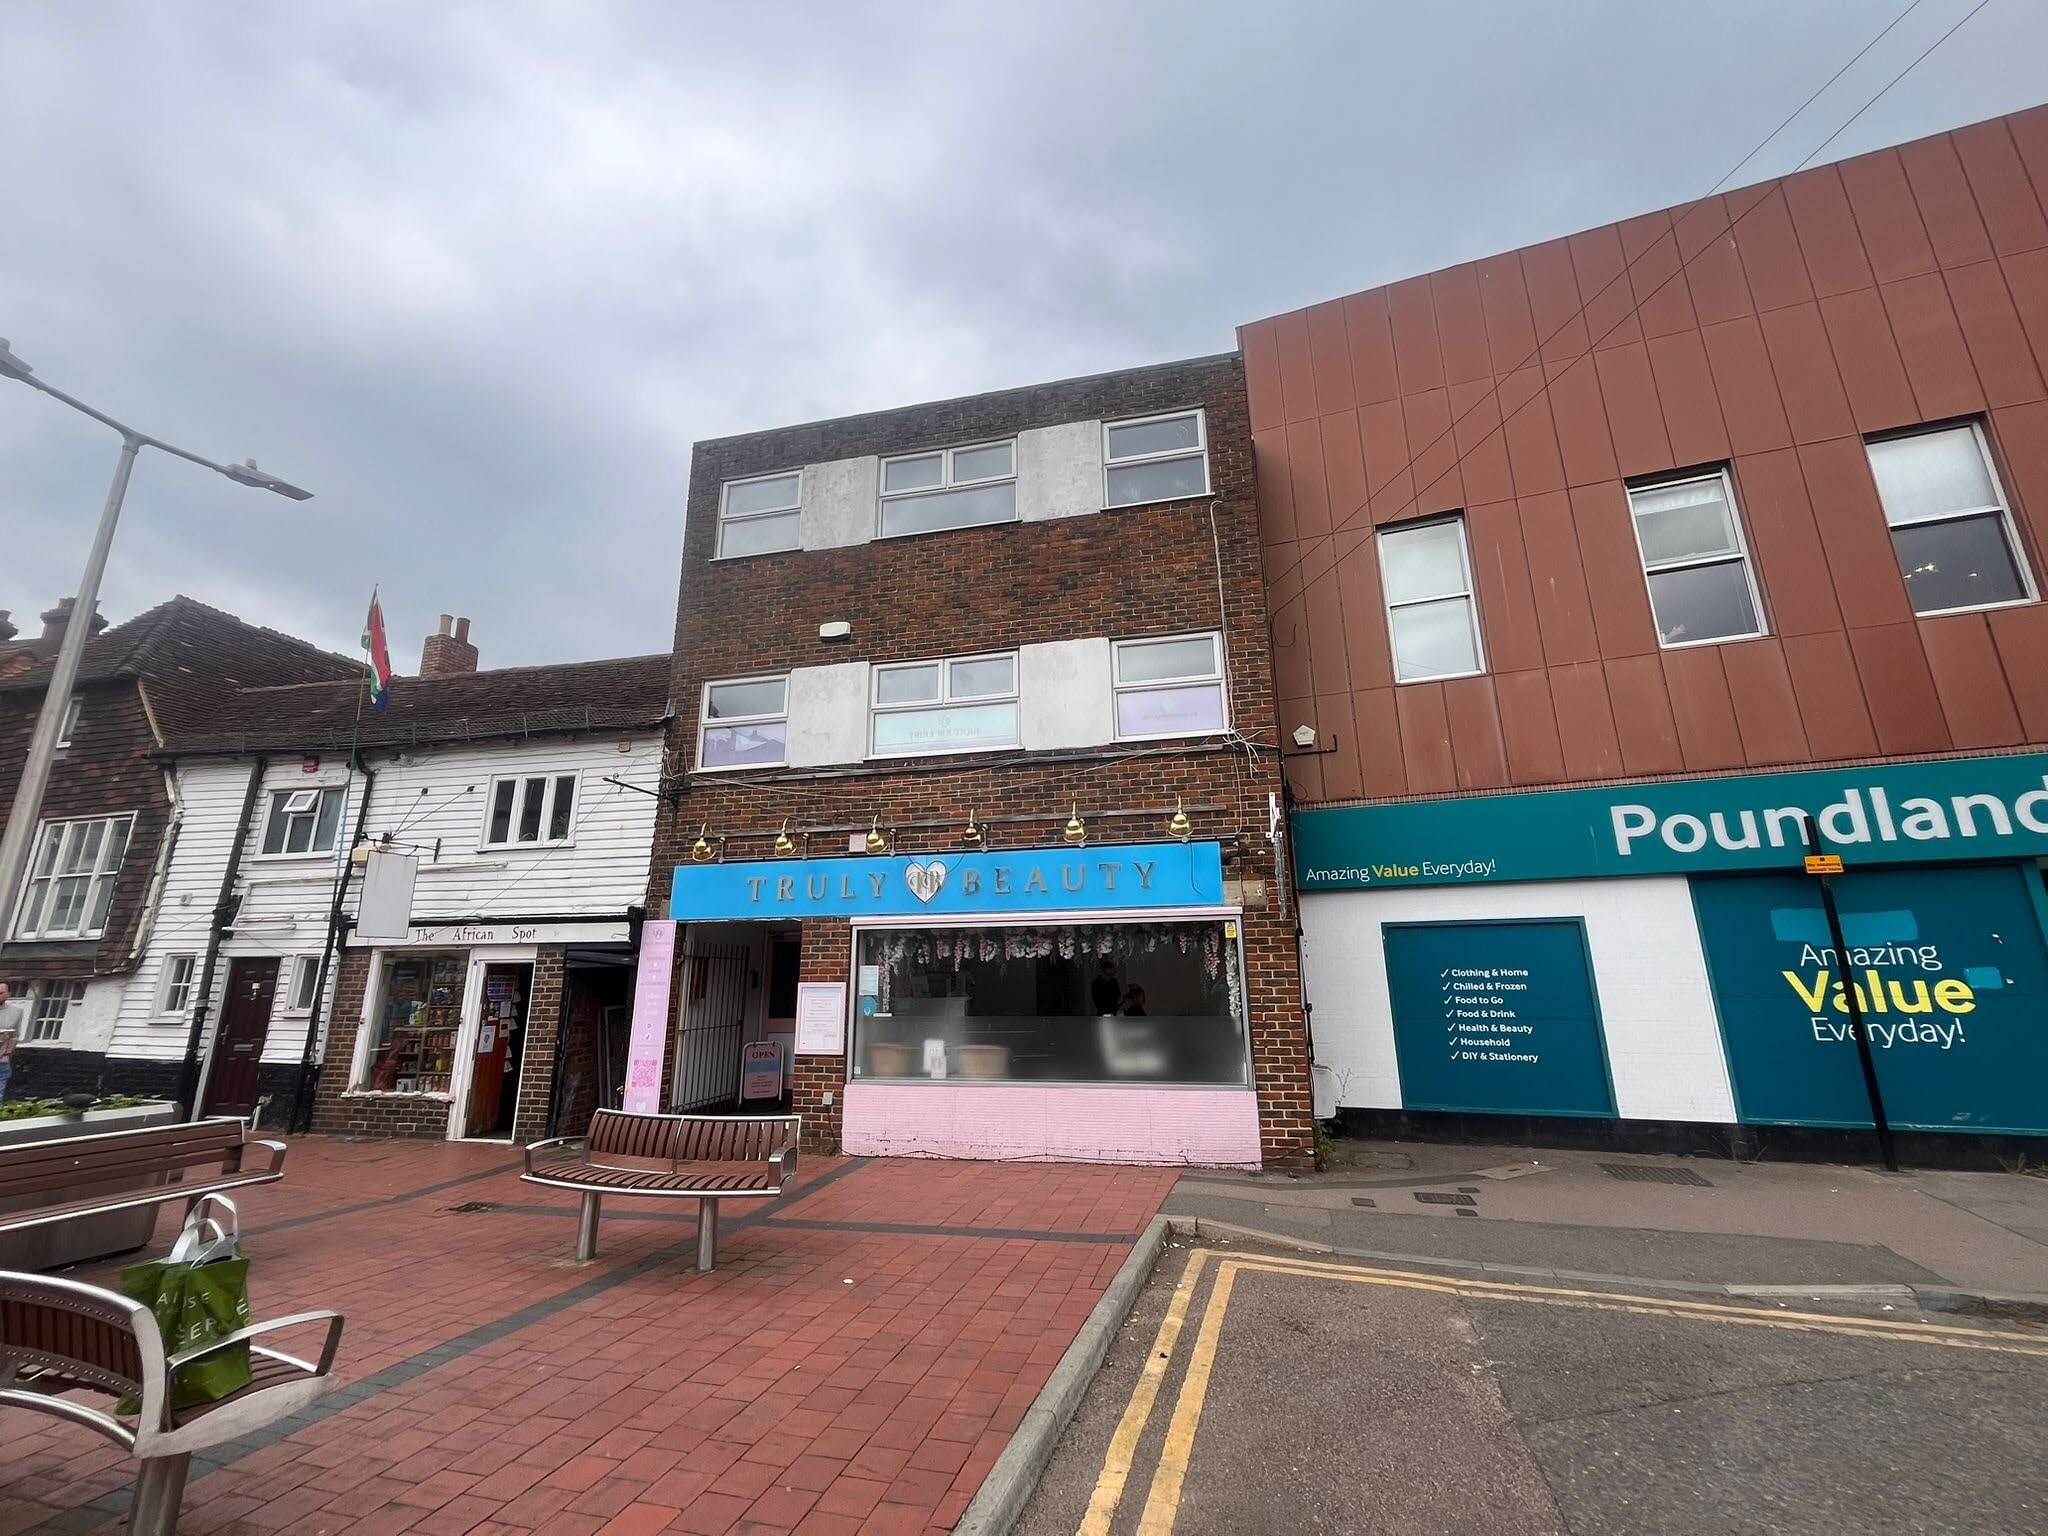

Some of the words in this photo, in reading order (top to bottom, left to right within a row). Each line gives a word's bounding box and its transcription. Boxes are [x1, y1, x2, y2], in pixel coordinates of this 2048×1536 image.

[1306, 866, 1370, 882] Amazing
[1371, 863, 1419, 878] Value
[1422, 858, 1496, 877] Everyday!
[747, 872, 888, 902] TRULY
[962, 861, 1155, 895] BEAUTY
[415, 929, 435, 942] The
[452, 926, 494, 941] African
[511, 926, 537, 943] Spot
[1451, 968, 1490, 978] Clothing
[1491, 968, 1498, 977] &
[1500, 968, 1529, 977] Home
[1453, 982, 1485, 990] Chilled
[1486, 982, 1494, 990] &
[1495, 982, 1527, 990] Frozen
[1782, 969, 1977, 1014] Value
[1455, 996, 1478, 1004] Food
[1479, 996, 1489, 1004] to
[1490, 996, 1504, 1004] Go
[1457, 1009, 1479, 1018] Food
[1481, 1010, 1488, 1018] &
[1490, 1009, 1516, 1018] Drink
[1458, 1023, 1489, 1032] Health
[1490, 1024, 1498, 1032] &
[1500, 1024, 1533, 1034] Beauty
[1460, 1037, 1511, 1046] Household
[752, 1051, 775, 1059] OPEN
[1462, 1052, 1478, 1060] DIY
[1480, 1052, 1488, 1060] &
[1489, 1052, 1539, 1064] Stationery
